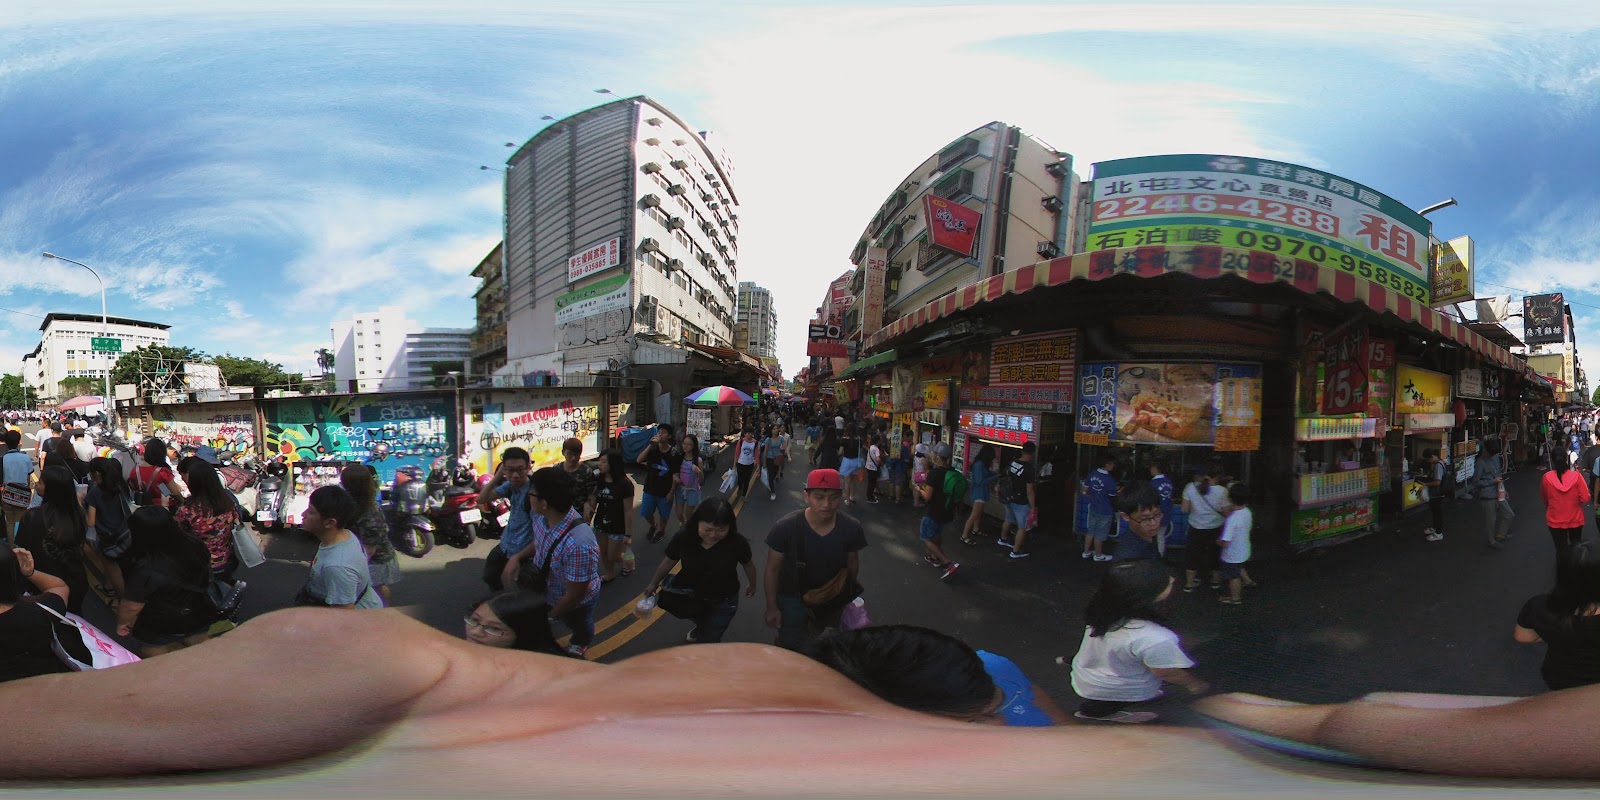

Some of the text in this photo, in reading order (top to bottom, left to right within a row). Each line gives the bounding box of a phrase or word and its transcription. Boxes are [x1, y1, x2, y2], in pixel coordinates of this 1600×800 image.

[1097, 195, 1336, 234] 2246-4288
[1355, 213, 1422, 271] 租
[1236, 230, 1425, 304] 0970-958582
[994, 336, 1071, 363] 金牌巨無霸
[1000, 363, 1060, 383] 香酥臭豆腐
[511, 404, 559, 427] WELCOME
[560, 399, 574, 416] TO
[974, 411, 1034, 432] 金牌巨無霸
